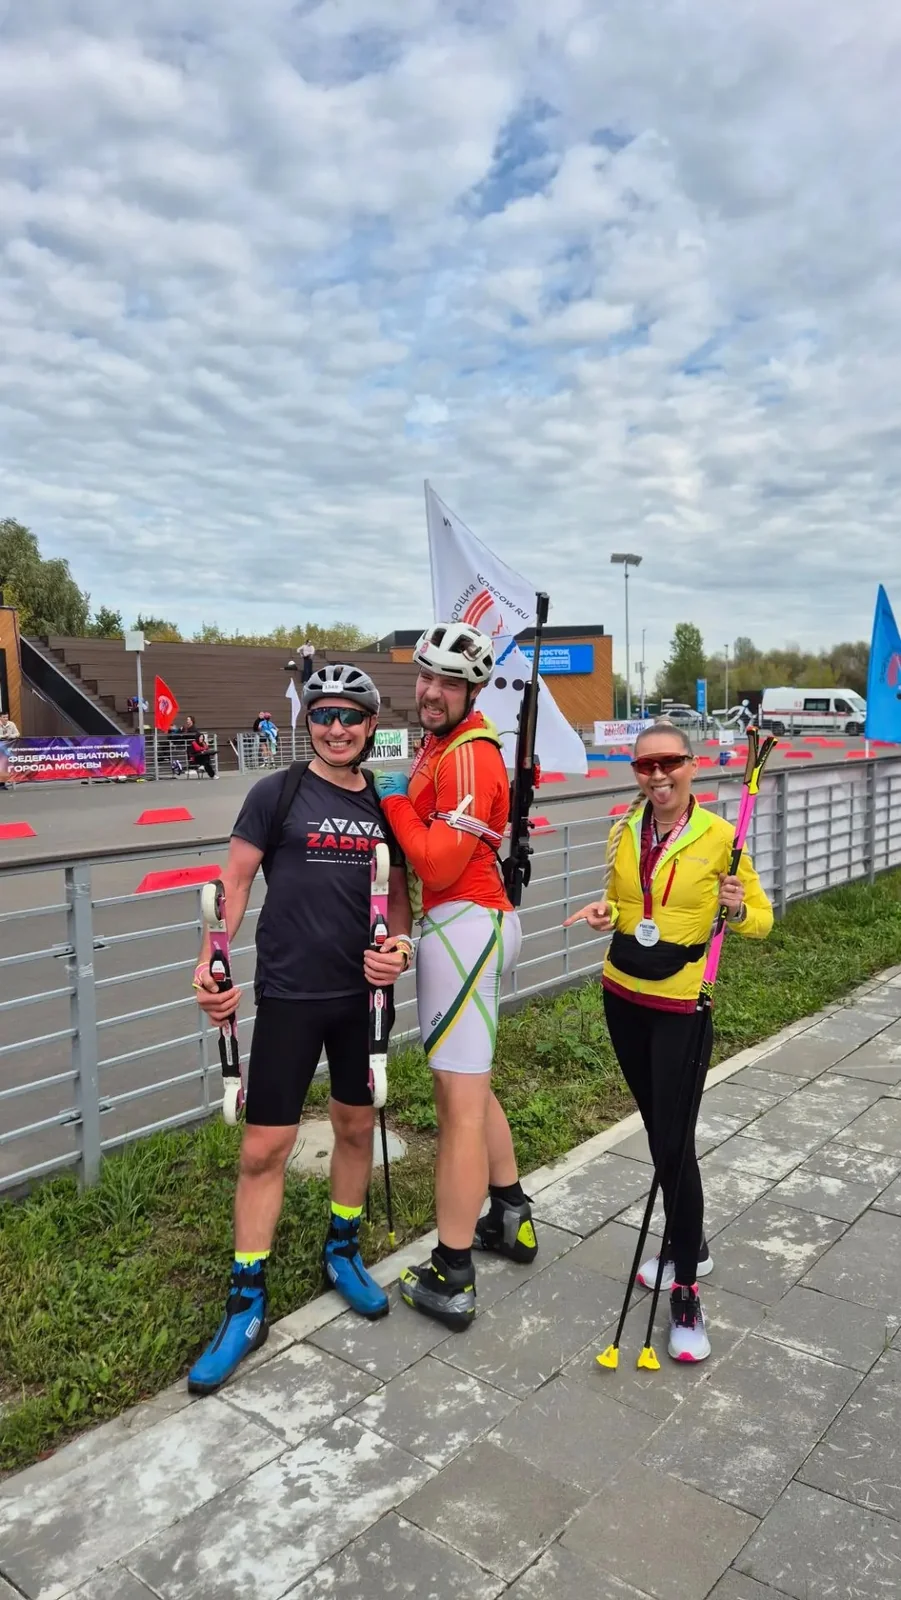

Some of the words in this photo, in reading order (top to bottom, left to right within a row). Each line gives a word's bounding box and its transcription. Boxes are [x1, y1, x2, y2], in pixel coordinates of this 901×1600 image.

[8, 753, 75, 763] ФЕДЕРАЦИЯ
[77, 751, 130, 760] БИАТЛОНА
[370, 745, 402, 758] ИАТЛОН
[8, 764, 53, 773] ГОРОДА
[55, 761, 102, 770] МОСКВЫ
